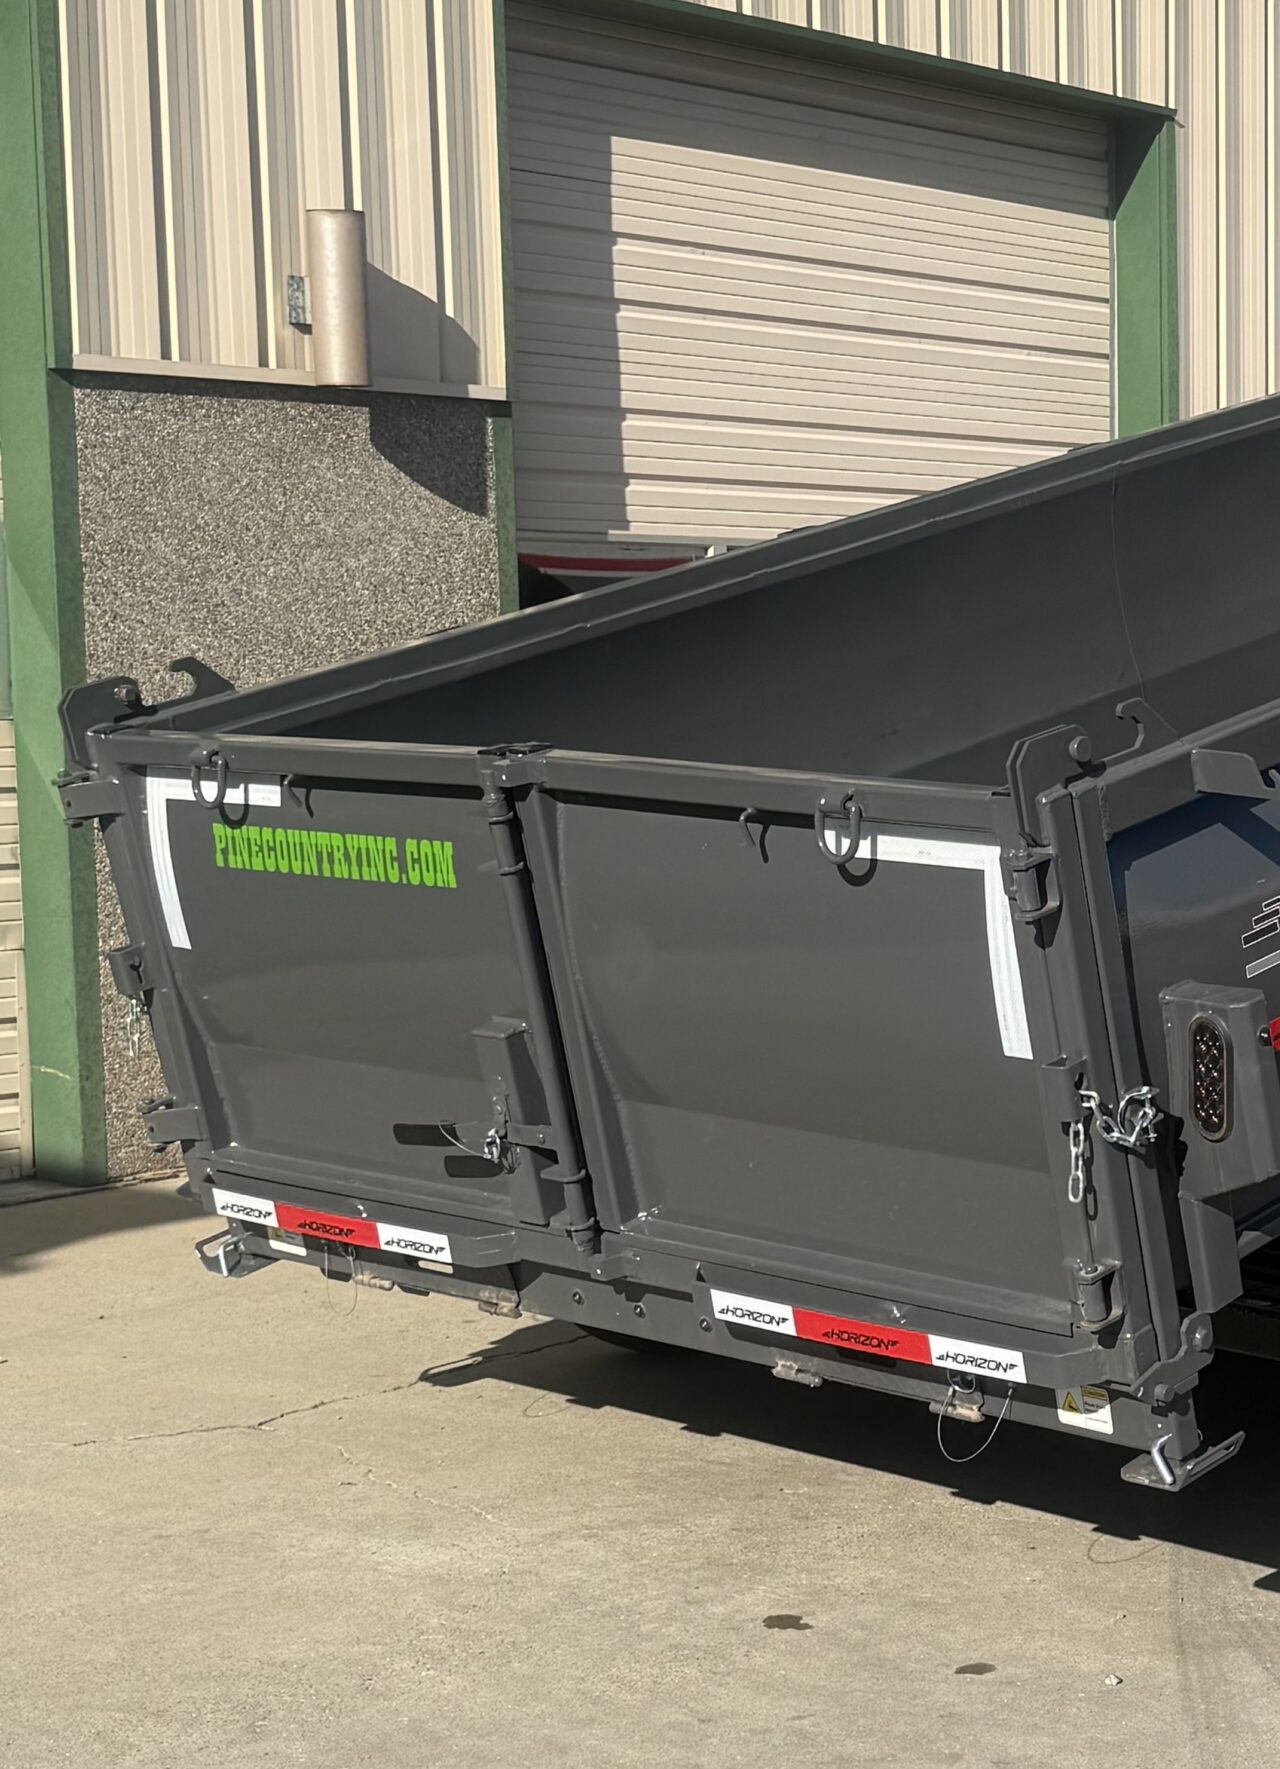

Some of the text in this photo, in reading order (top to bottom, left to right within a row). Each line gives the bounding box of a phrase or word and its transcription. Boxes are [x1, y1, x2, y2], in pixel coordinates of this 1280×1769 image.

[212, 822, 457, 888] PINECOUNTRYINC.COM
[220, 1202, 446, 1256] HORIZON HORIZON HORIZON
[717, 1305, 1019, 1374] HORIZON HORIZON HORIZON
